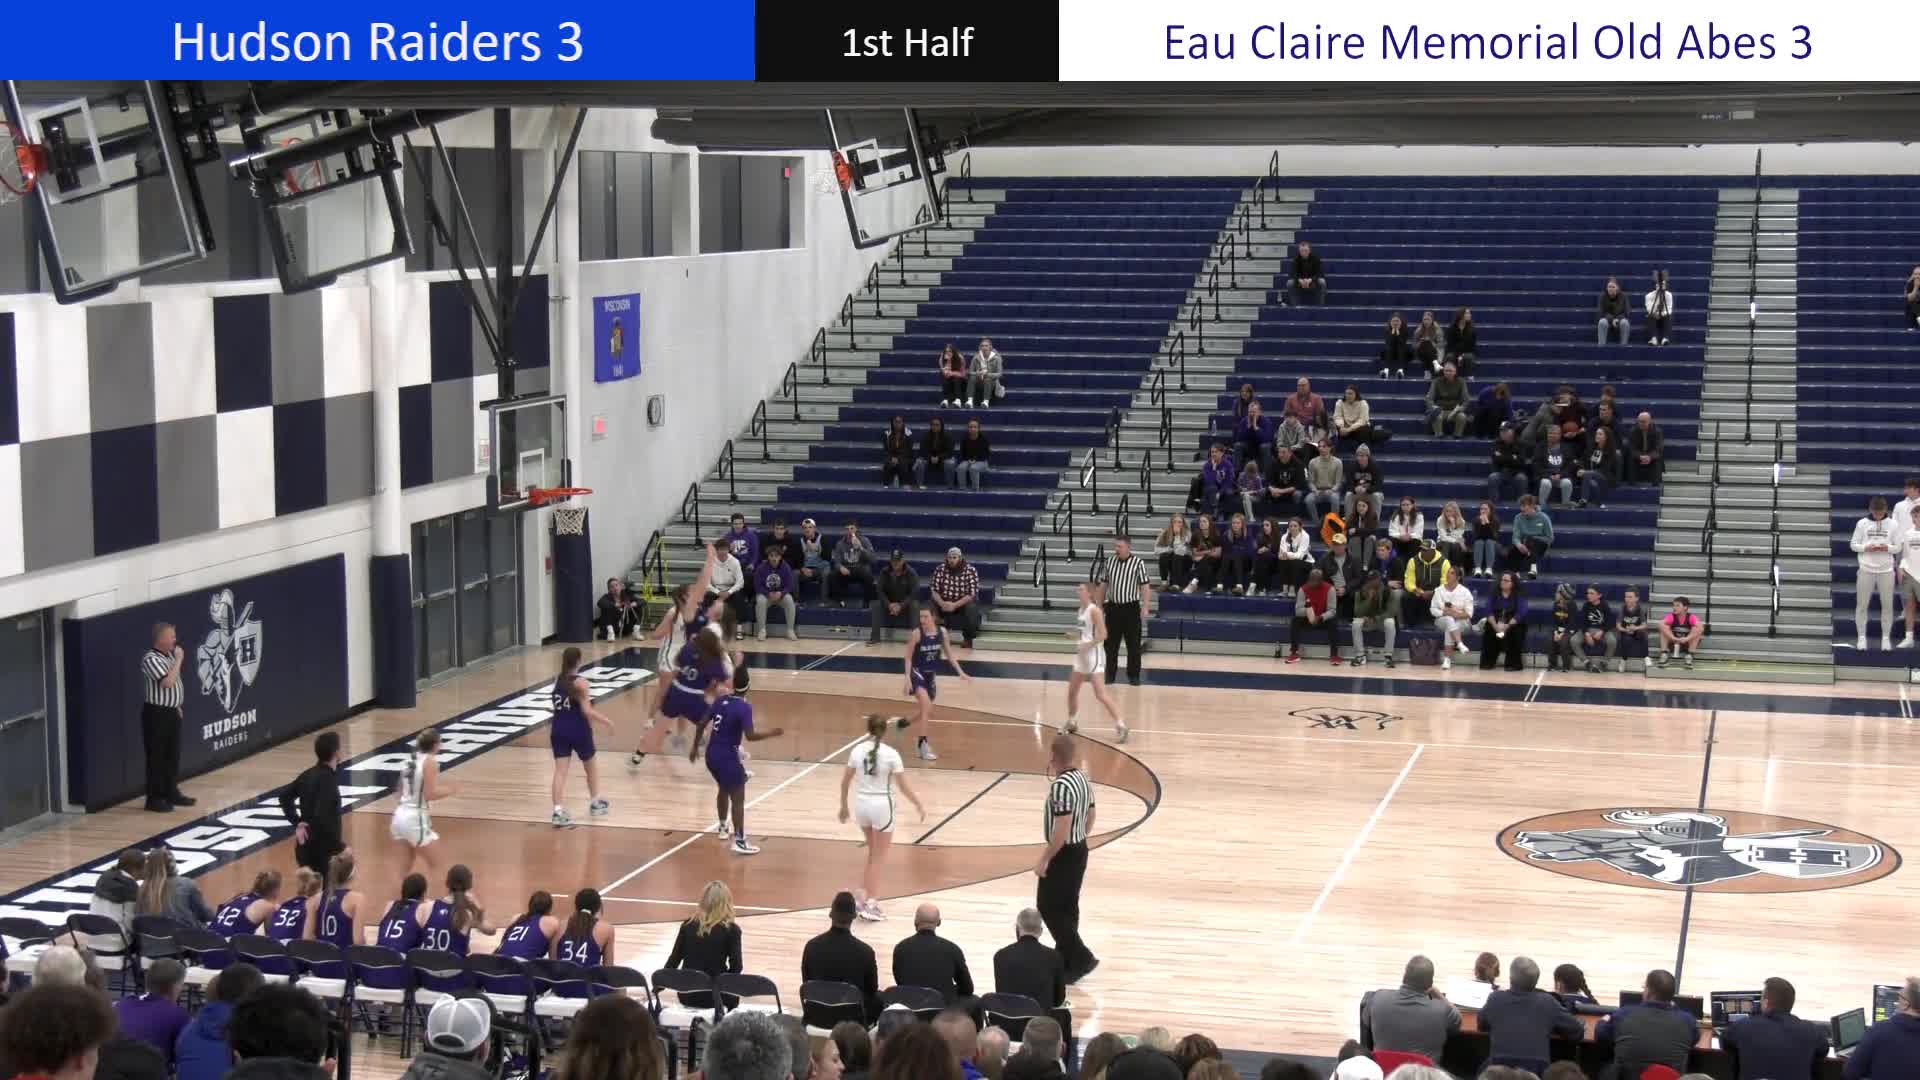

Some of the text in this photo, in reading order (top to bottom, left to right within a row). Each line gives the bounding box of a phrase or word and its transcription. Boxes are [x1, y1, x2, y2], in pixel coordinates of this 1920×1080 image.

[554, 694, 571, 710] 24
[202, 709, 257, 740] HUDSON
[213, 731, 249, 751] RAIDERS
[216, 906, 241, 926] 42
[274, 908, 301, 927] 32
[321, 915, 337, 936] 10
[385, 919, 406, 938] 15
[508, 926, 529, 942] 21
[424, 927, 450, 951] 30
[561, 940, 588, 963] 34
